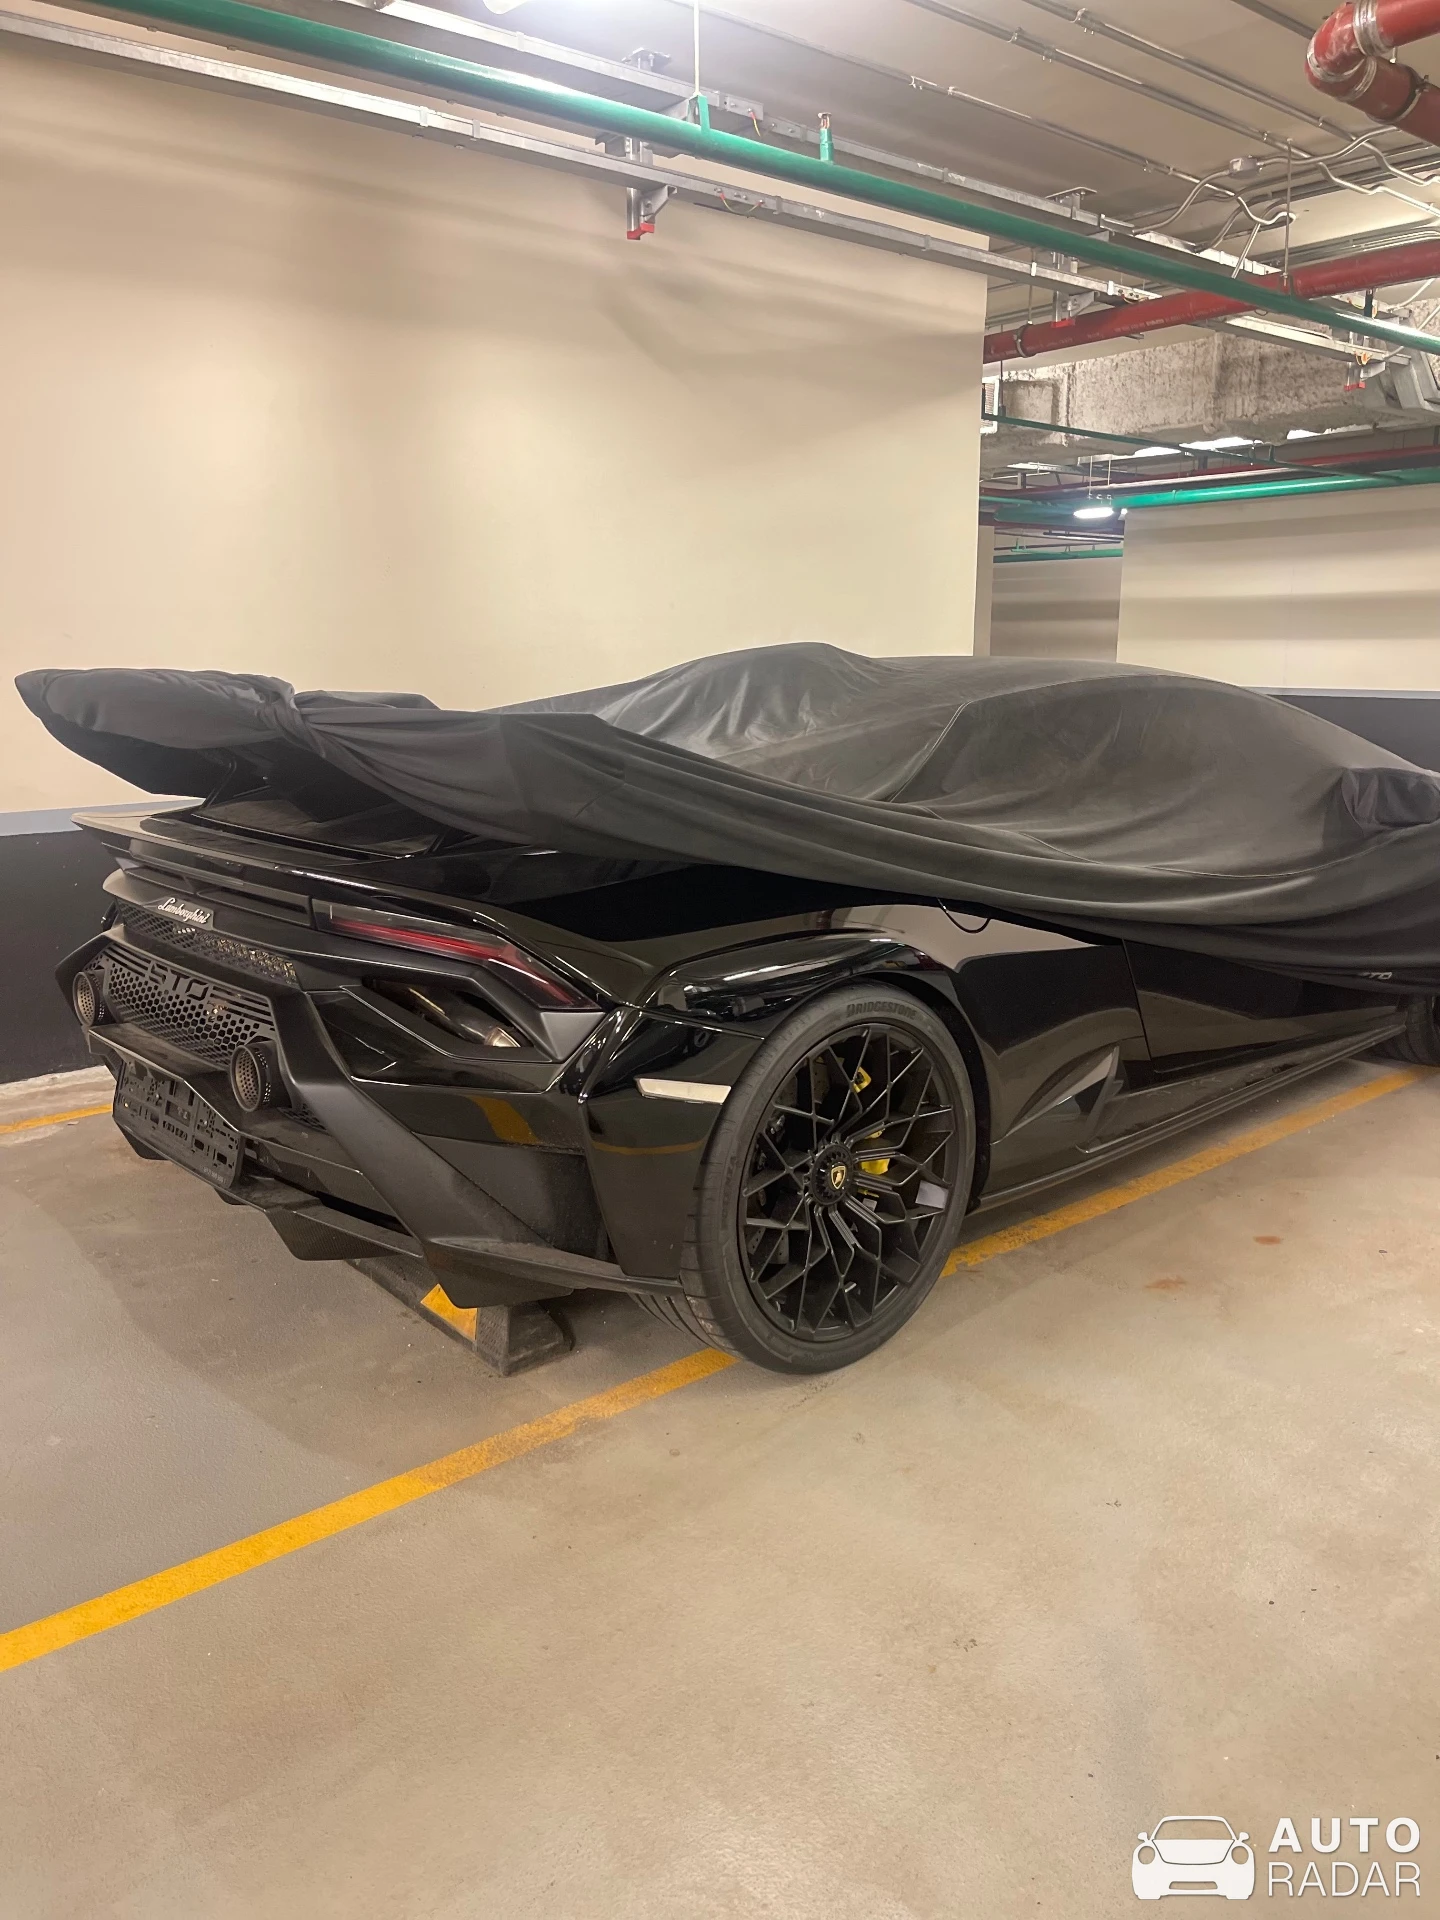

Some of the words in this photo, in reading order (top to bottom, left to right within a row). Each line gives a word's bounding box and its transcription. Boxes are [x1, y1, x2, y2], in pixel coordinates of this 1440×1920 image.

[157, 897, 211, 924] Lamborghini
[149, 962, 209, 1001] STO
[846, 1000, 918, 1020] BRIDGESTONE
